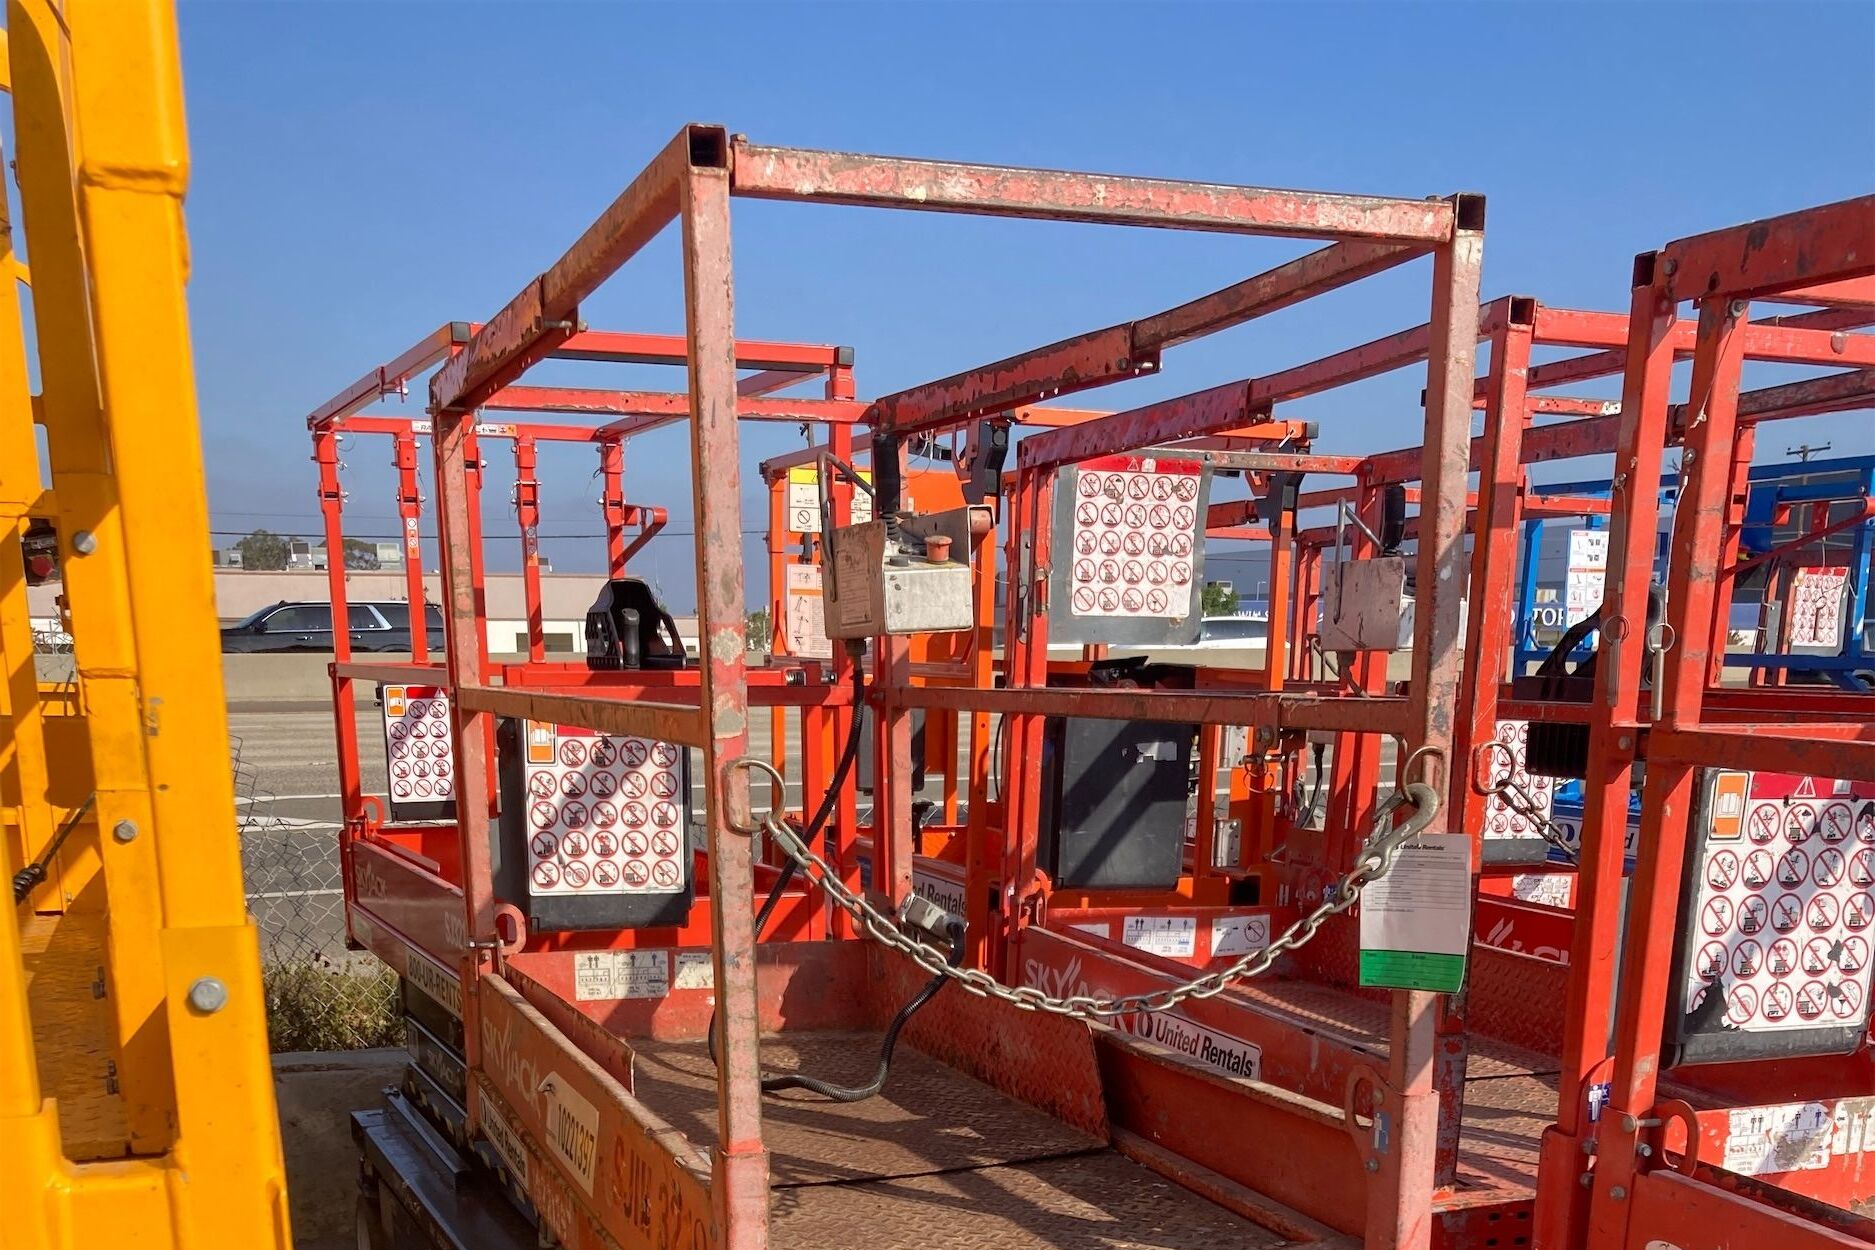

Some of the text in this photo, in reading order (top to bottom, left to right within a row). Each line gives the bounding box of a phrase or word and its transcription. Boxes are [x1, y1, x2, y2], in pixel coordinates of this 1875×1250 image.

[1155, 1017, 1254, 1078] United Rentals
[557, 1103, 596, 1181] 10221397
